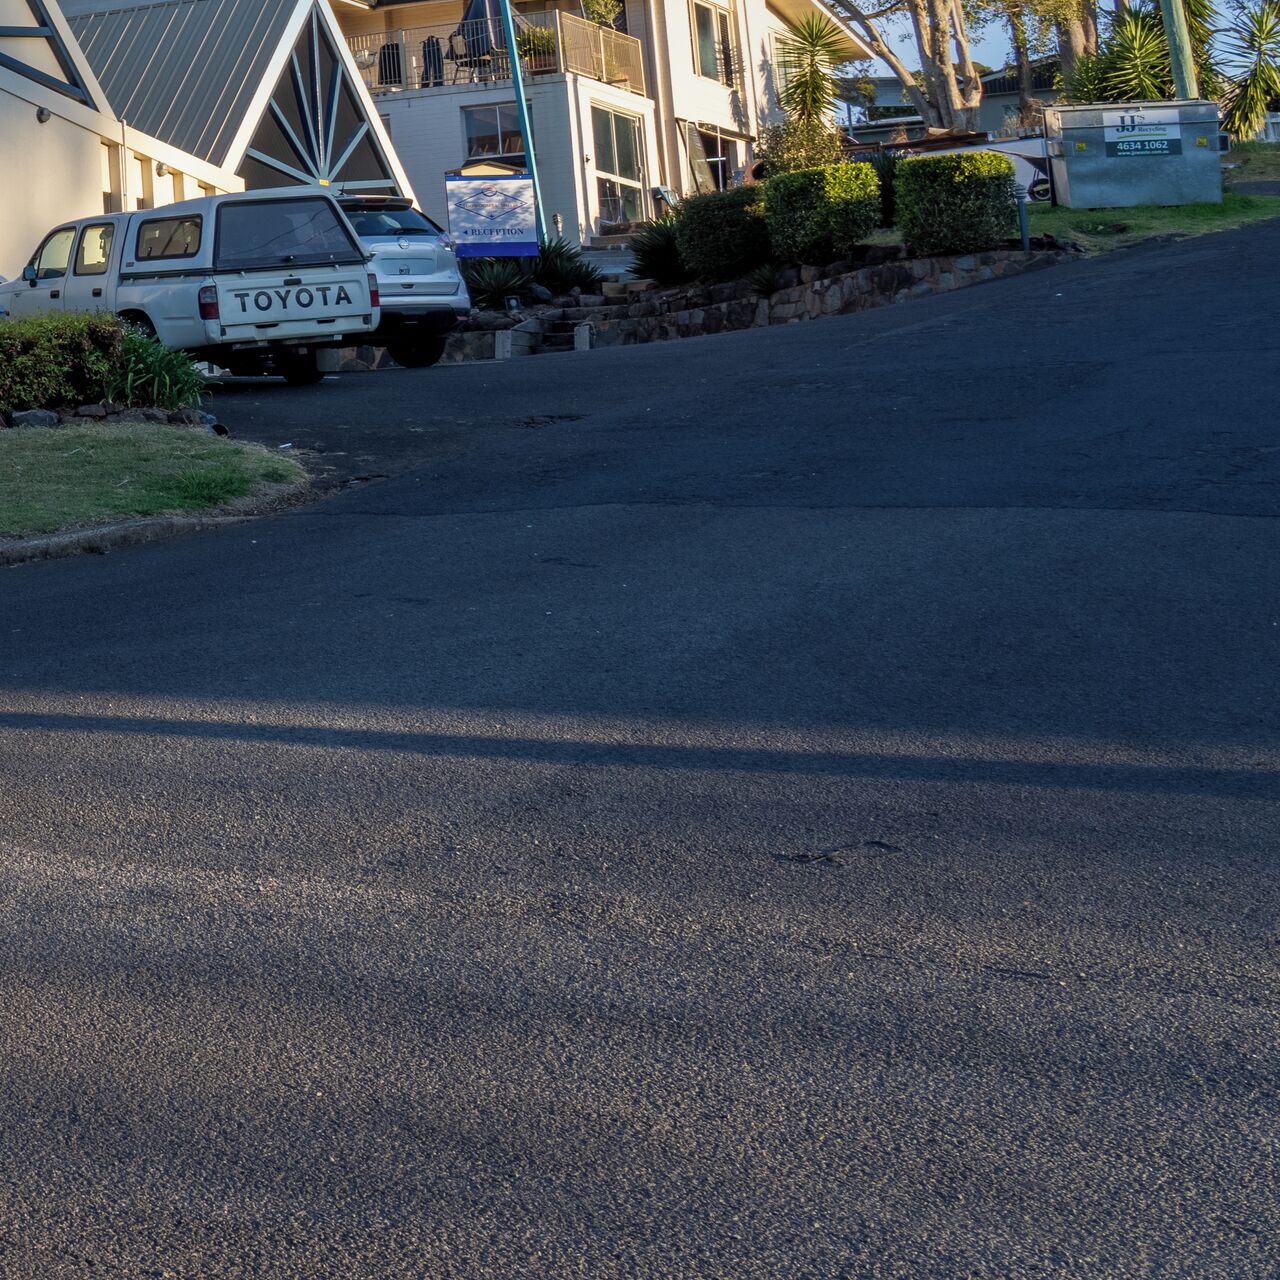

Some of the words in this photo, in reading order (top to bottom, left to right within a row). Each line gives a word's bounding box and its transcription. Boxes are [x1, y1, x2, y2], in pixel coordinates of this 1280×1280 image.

[1117, 142, 1142, 150] 4634
[1144, 141, 1169, 149] 1062
[471, 228, 524, 236] RECEPTION
[234, 286, 353, 313] TOYOTA
